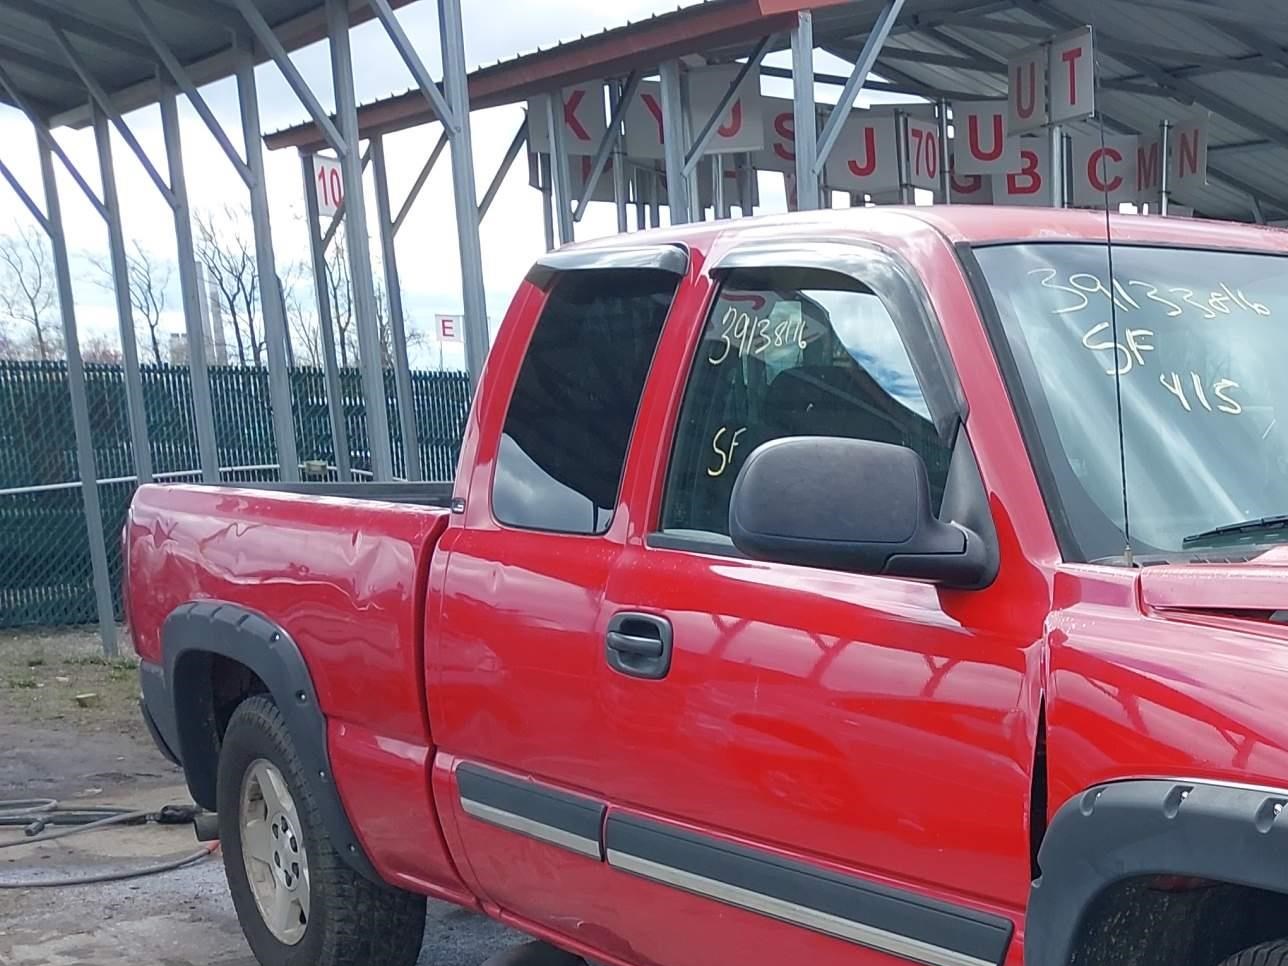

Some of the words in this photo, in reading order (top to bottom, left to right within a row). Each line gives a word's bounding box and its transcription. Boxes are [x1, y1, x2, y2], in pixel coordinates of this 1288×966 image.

[1015, 61, 1035, 119] U
[1062, 47, 1082, 105] T
[563, 90, 592, 141] K
[968, 114, 1003, 161] U
[847, 127, 876, 177] J
[911, 128, 937, 179] 70
[1006, 150, 1042, 195] B
[1087, 147, 1123, 192] C
[1137, 142, 1158, 191] M
[1179, 128, 1200, 178] N
[318, 166, 343, 209] 10
[441, 319, 455, 337] E
[708, 304, 808, 365] 39138116
[1082, 321, 1155, 376] SF
[707, 427, 747, 477] SF
